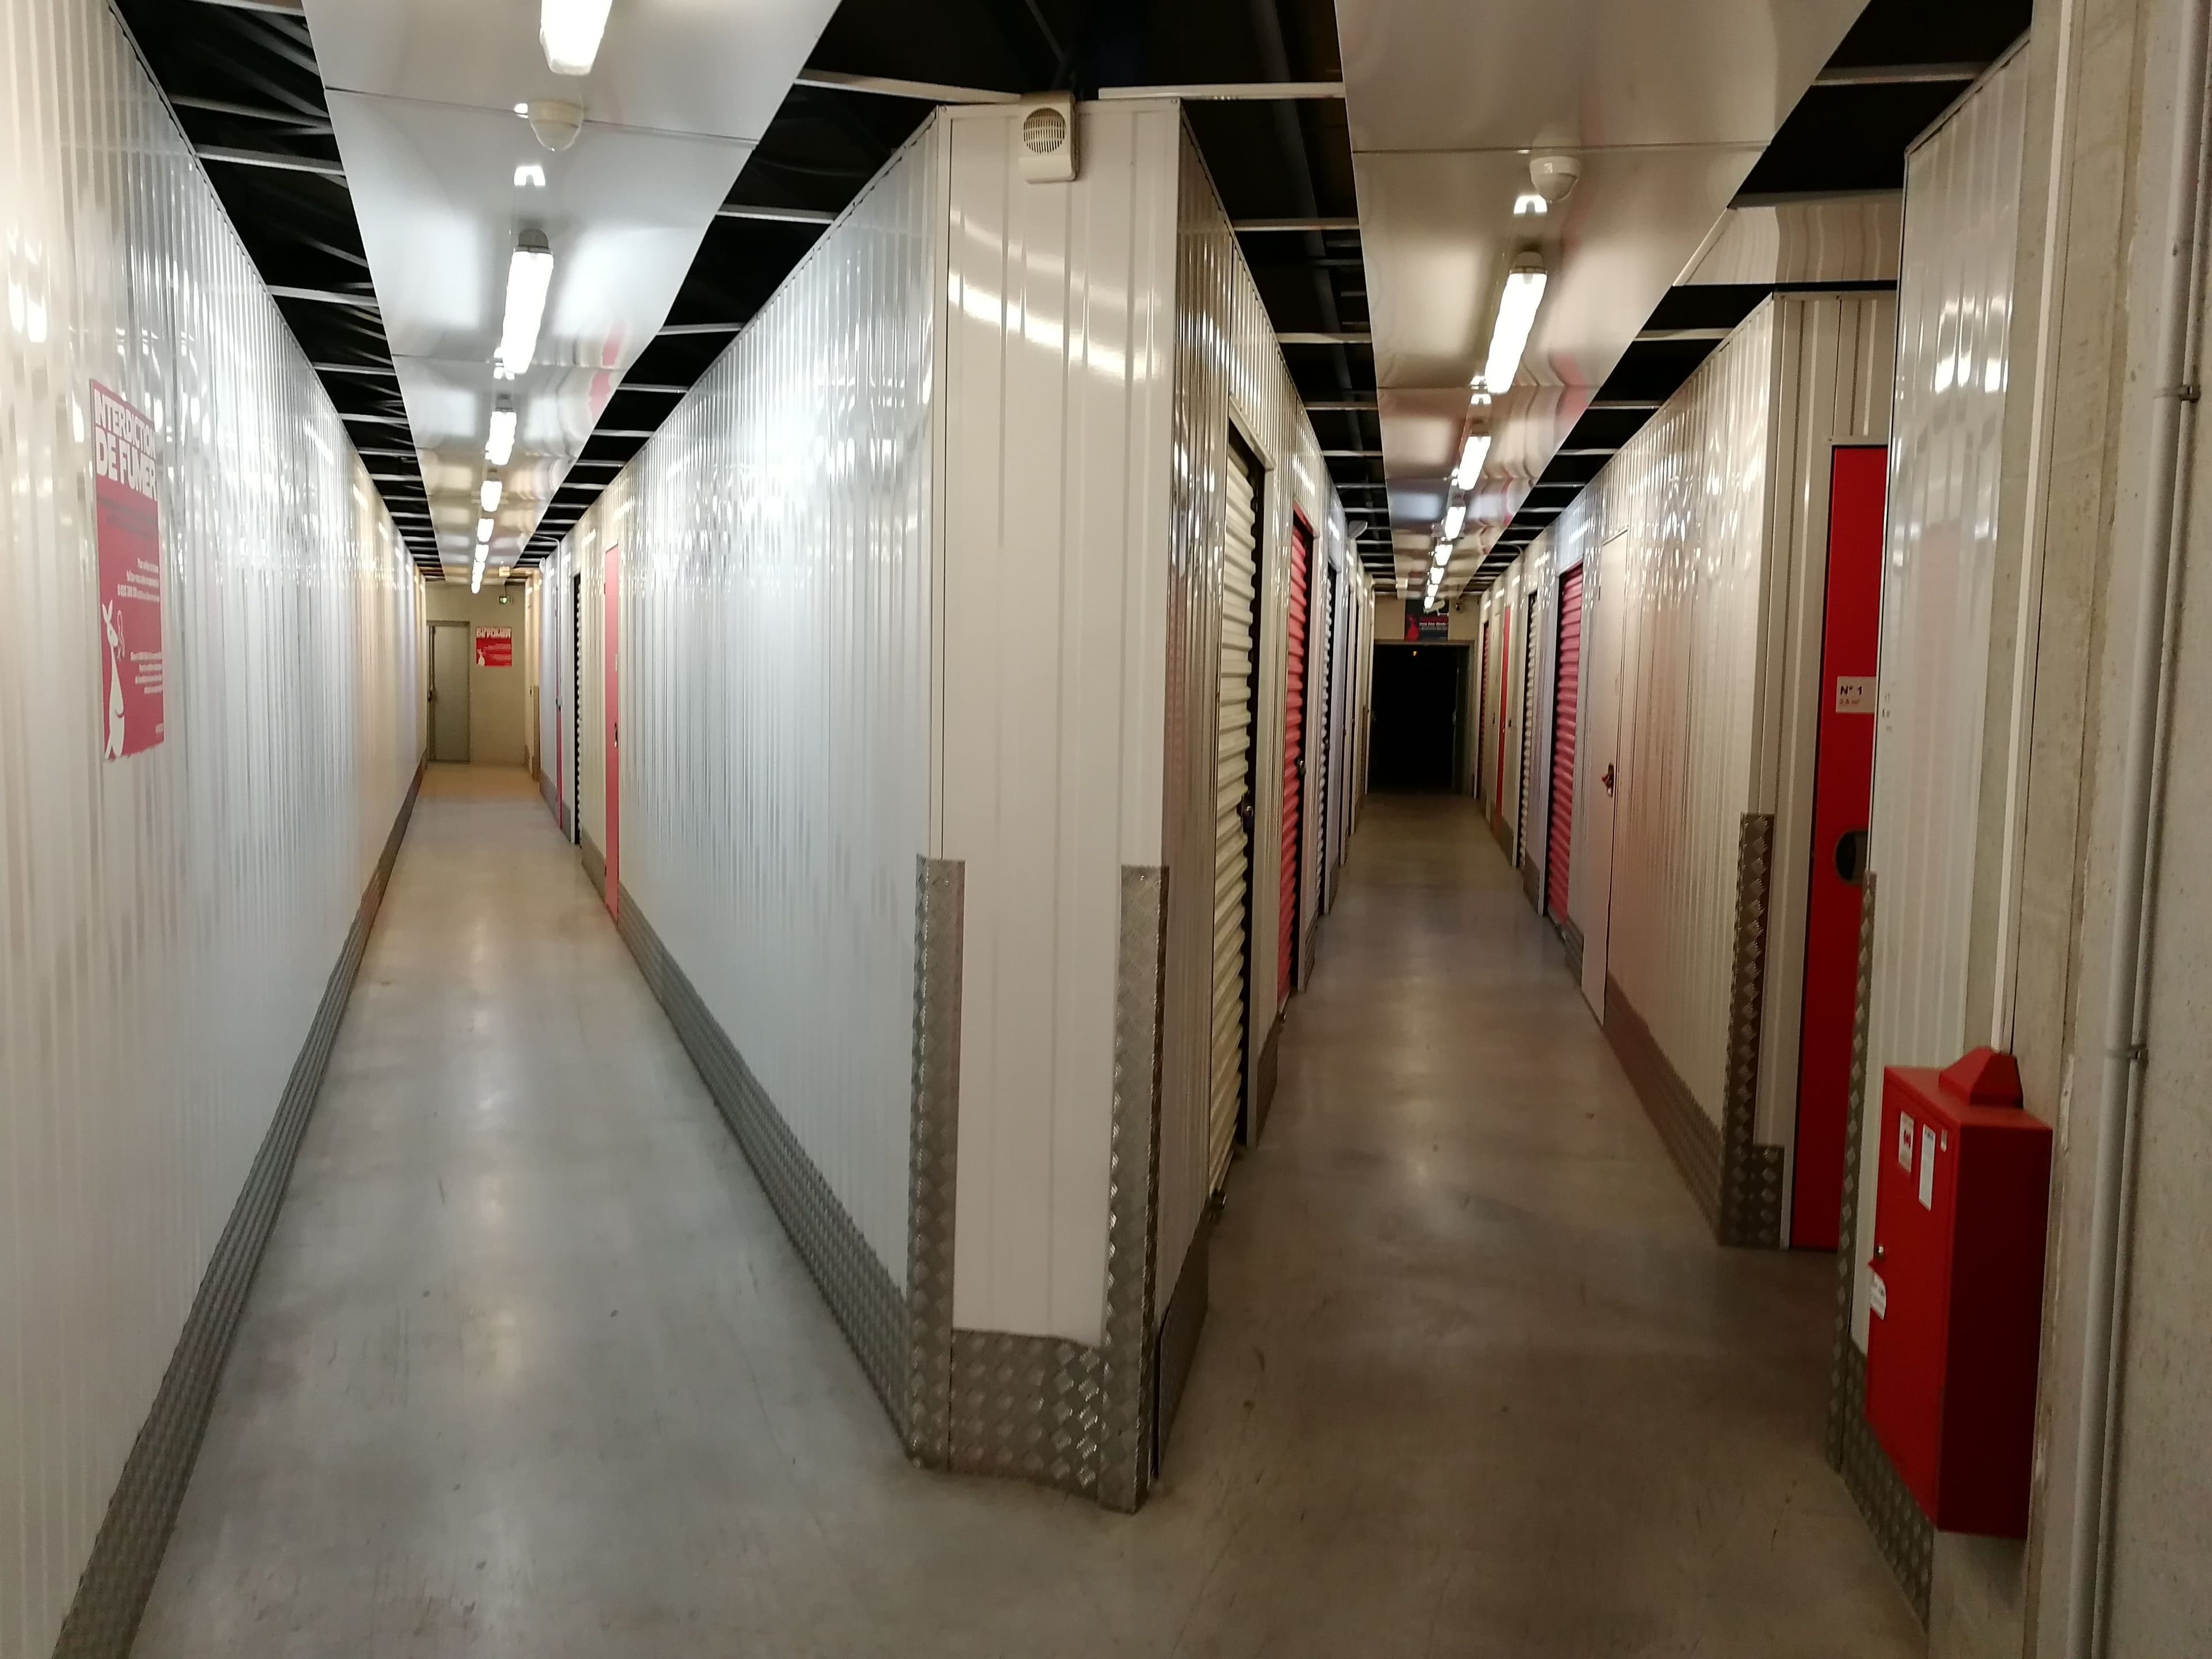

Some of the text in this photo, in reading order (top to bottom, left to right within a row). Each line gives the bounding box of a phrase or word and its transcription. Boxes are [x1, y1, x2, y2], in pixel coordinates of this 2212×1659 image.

[94, 388, 156, 461] INTERDICTION
[95, 426, 158, 502] DE FUMER
[1840, 685, 1862, 695] N° 1
